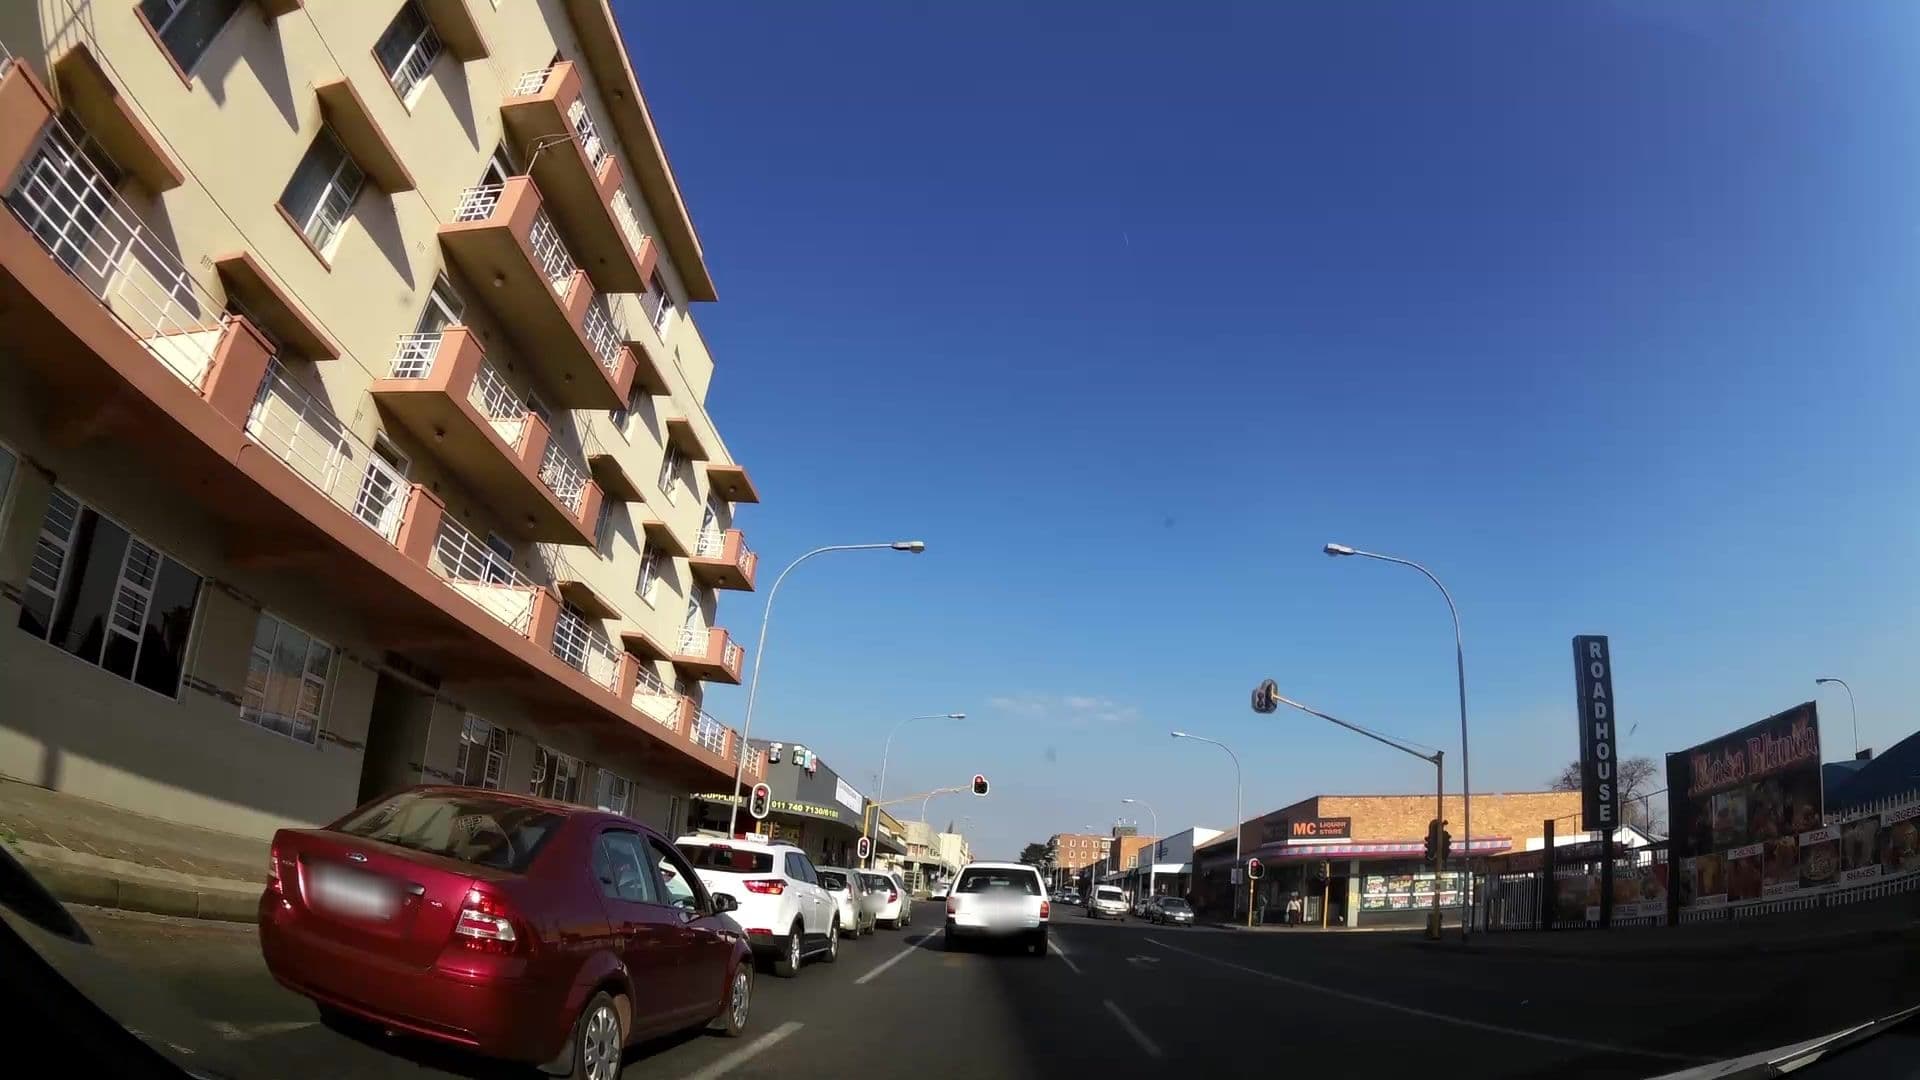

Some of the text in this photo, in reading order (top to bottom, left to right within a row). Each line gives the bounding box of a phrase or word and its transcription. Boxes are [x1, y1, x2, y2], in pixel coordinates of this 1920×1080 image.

[1588, 641, 1612, 822] ROADHOUSE
[771, 800, 785, 809] 011
[788, 803, 803, 812] 740
[1293, 822, 1317, 836] MC
[1809, 831, 1829, 841] PIZZA
